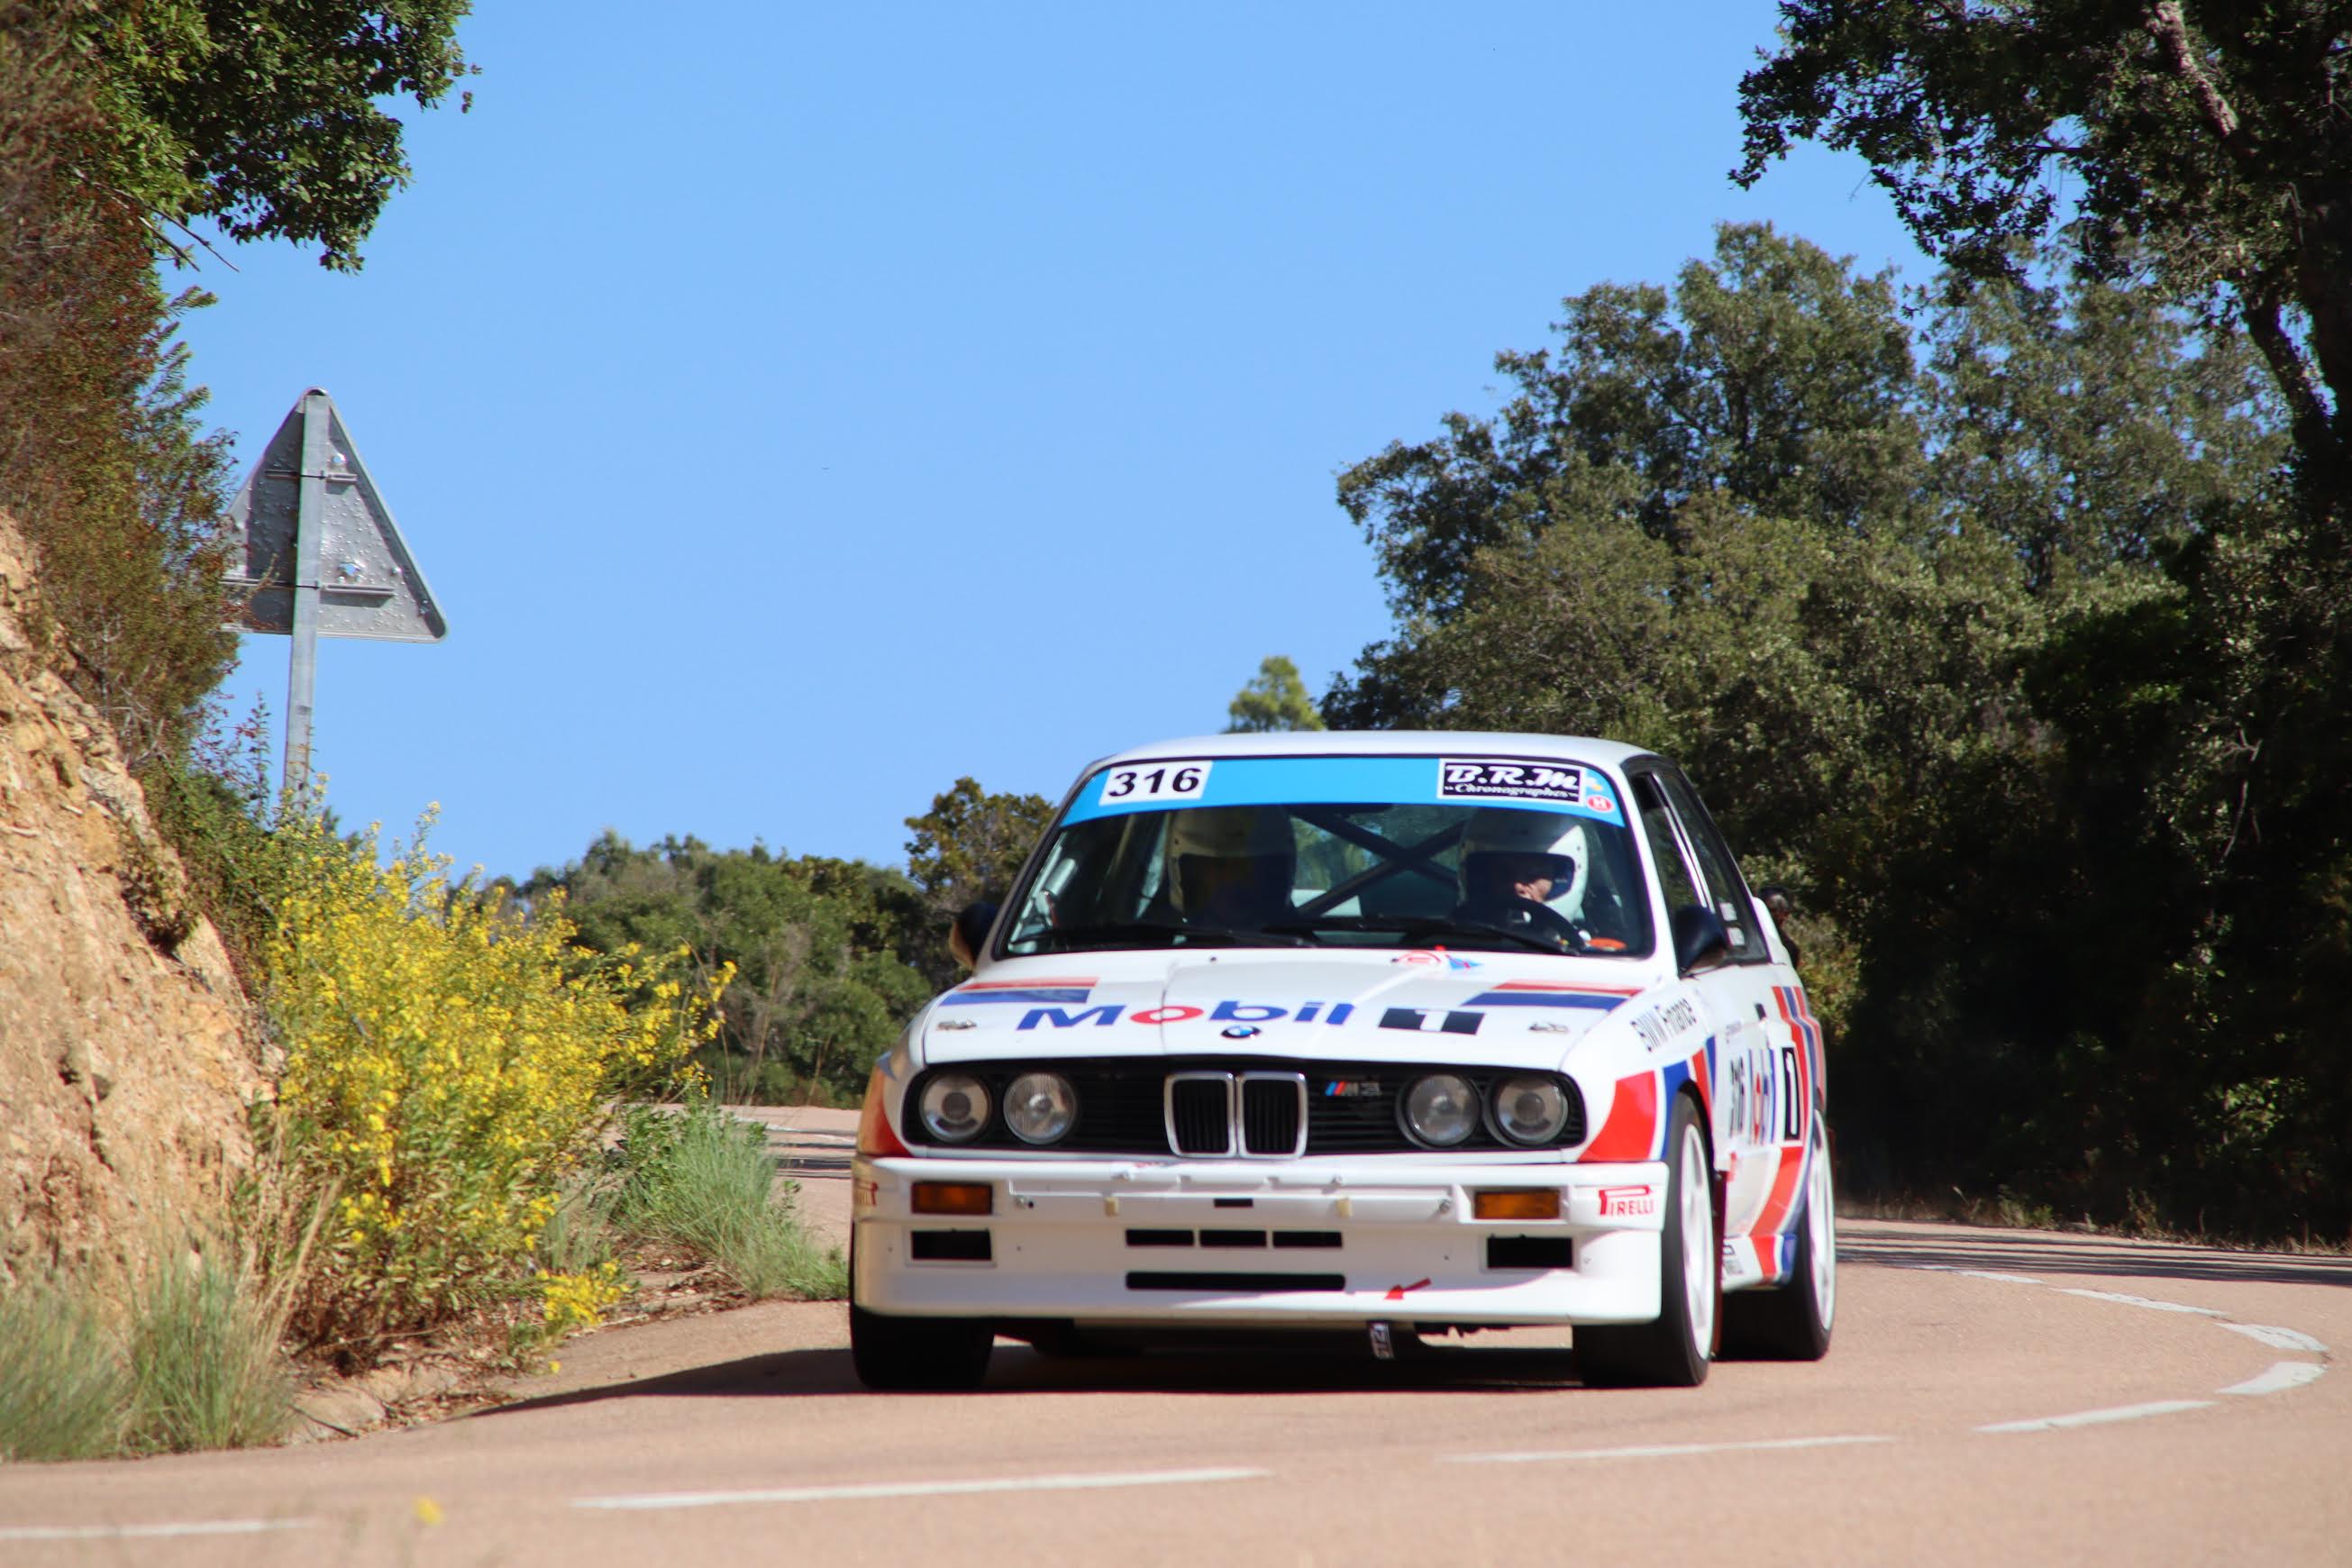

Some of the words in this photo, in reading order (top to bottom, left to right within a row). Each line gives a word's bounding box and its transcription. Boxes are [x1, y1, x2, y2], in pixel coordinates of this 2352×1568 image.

[1108, 768, 1202, 797] 316
[1016, 1001, 1355, 1031] Mobil
[1599, 1184, 1655, 1217] PIRELLI
